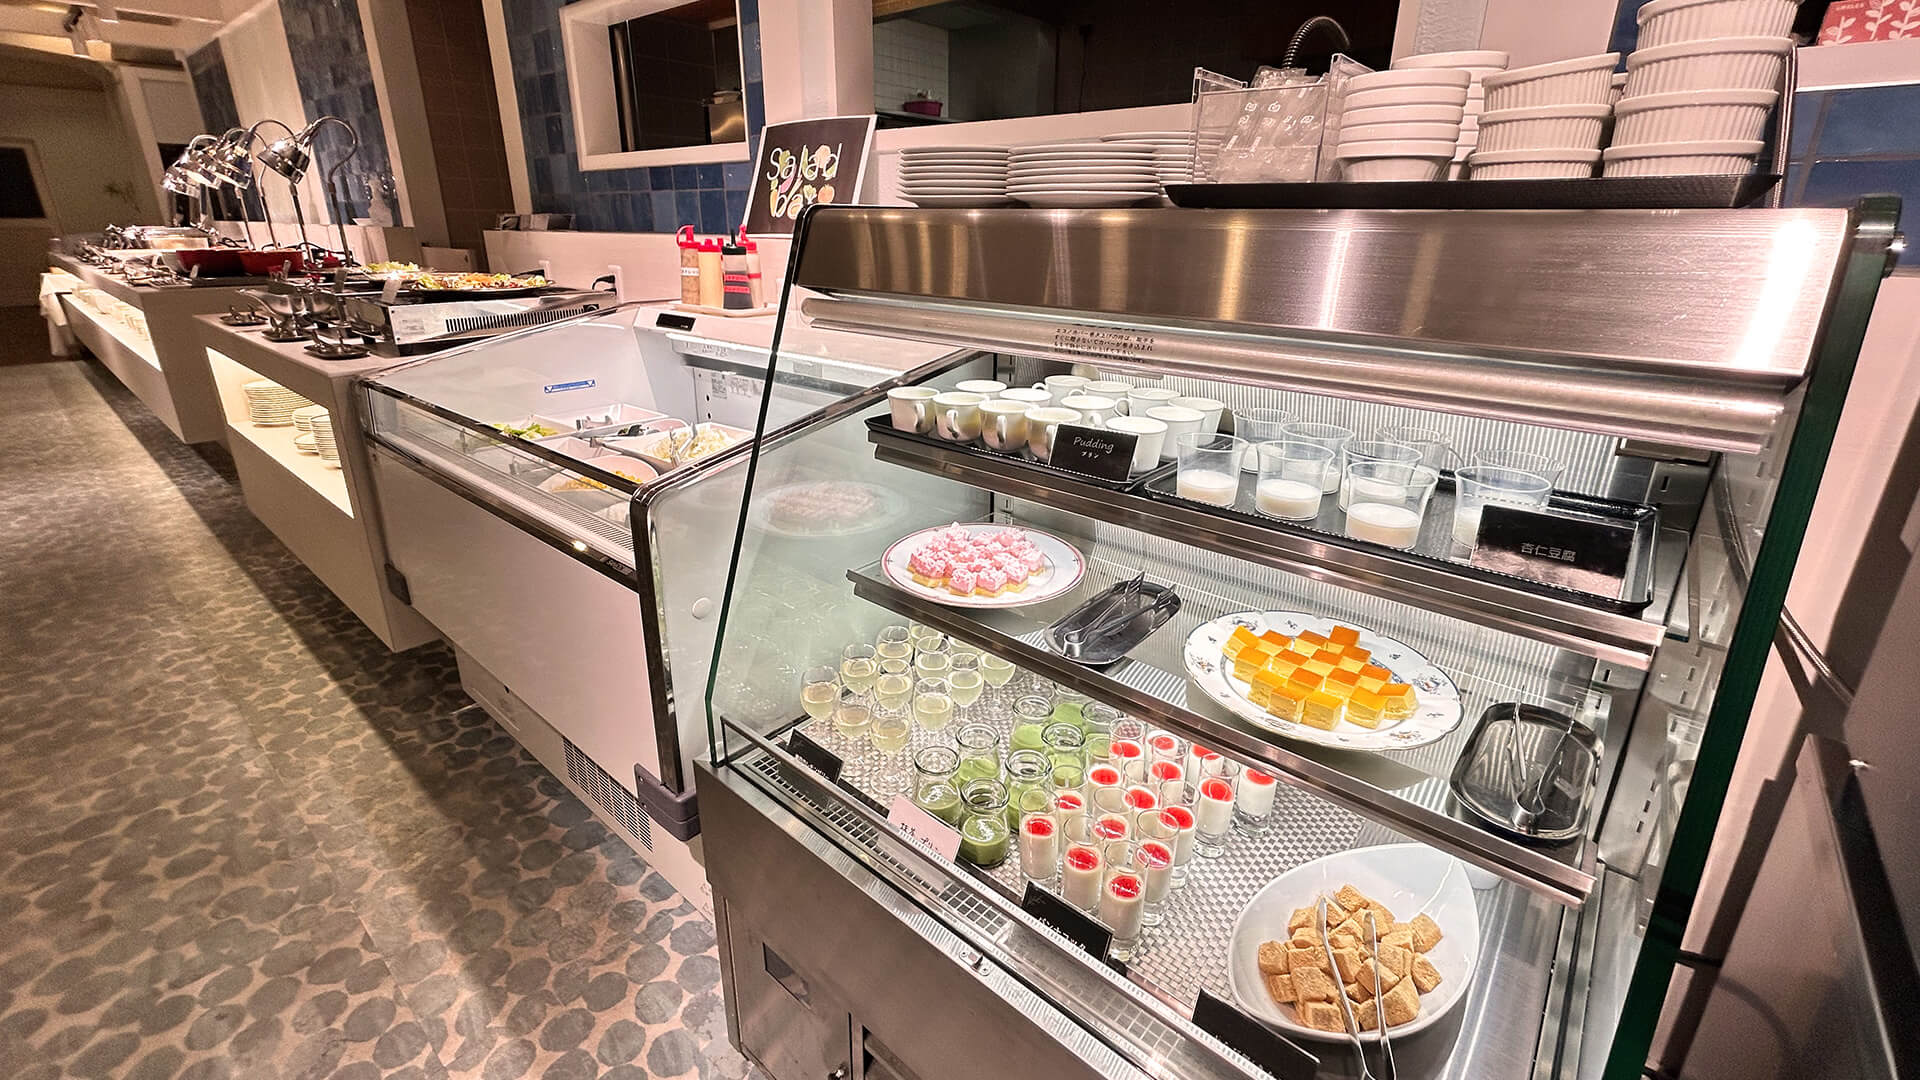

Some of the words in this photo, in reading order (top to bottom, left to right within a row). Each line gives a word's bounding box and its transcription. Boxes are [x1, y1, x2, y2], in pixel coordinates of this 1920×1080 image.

[766, 143, 842, 181] Salad
[1073, 436, 1114, 454] Pudding
[1521, 542, 1576, 562] 杏仁豆腐
